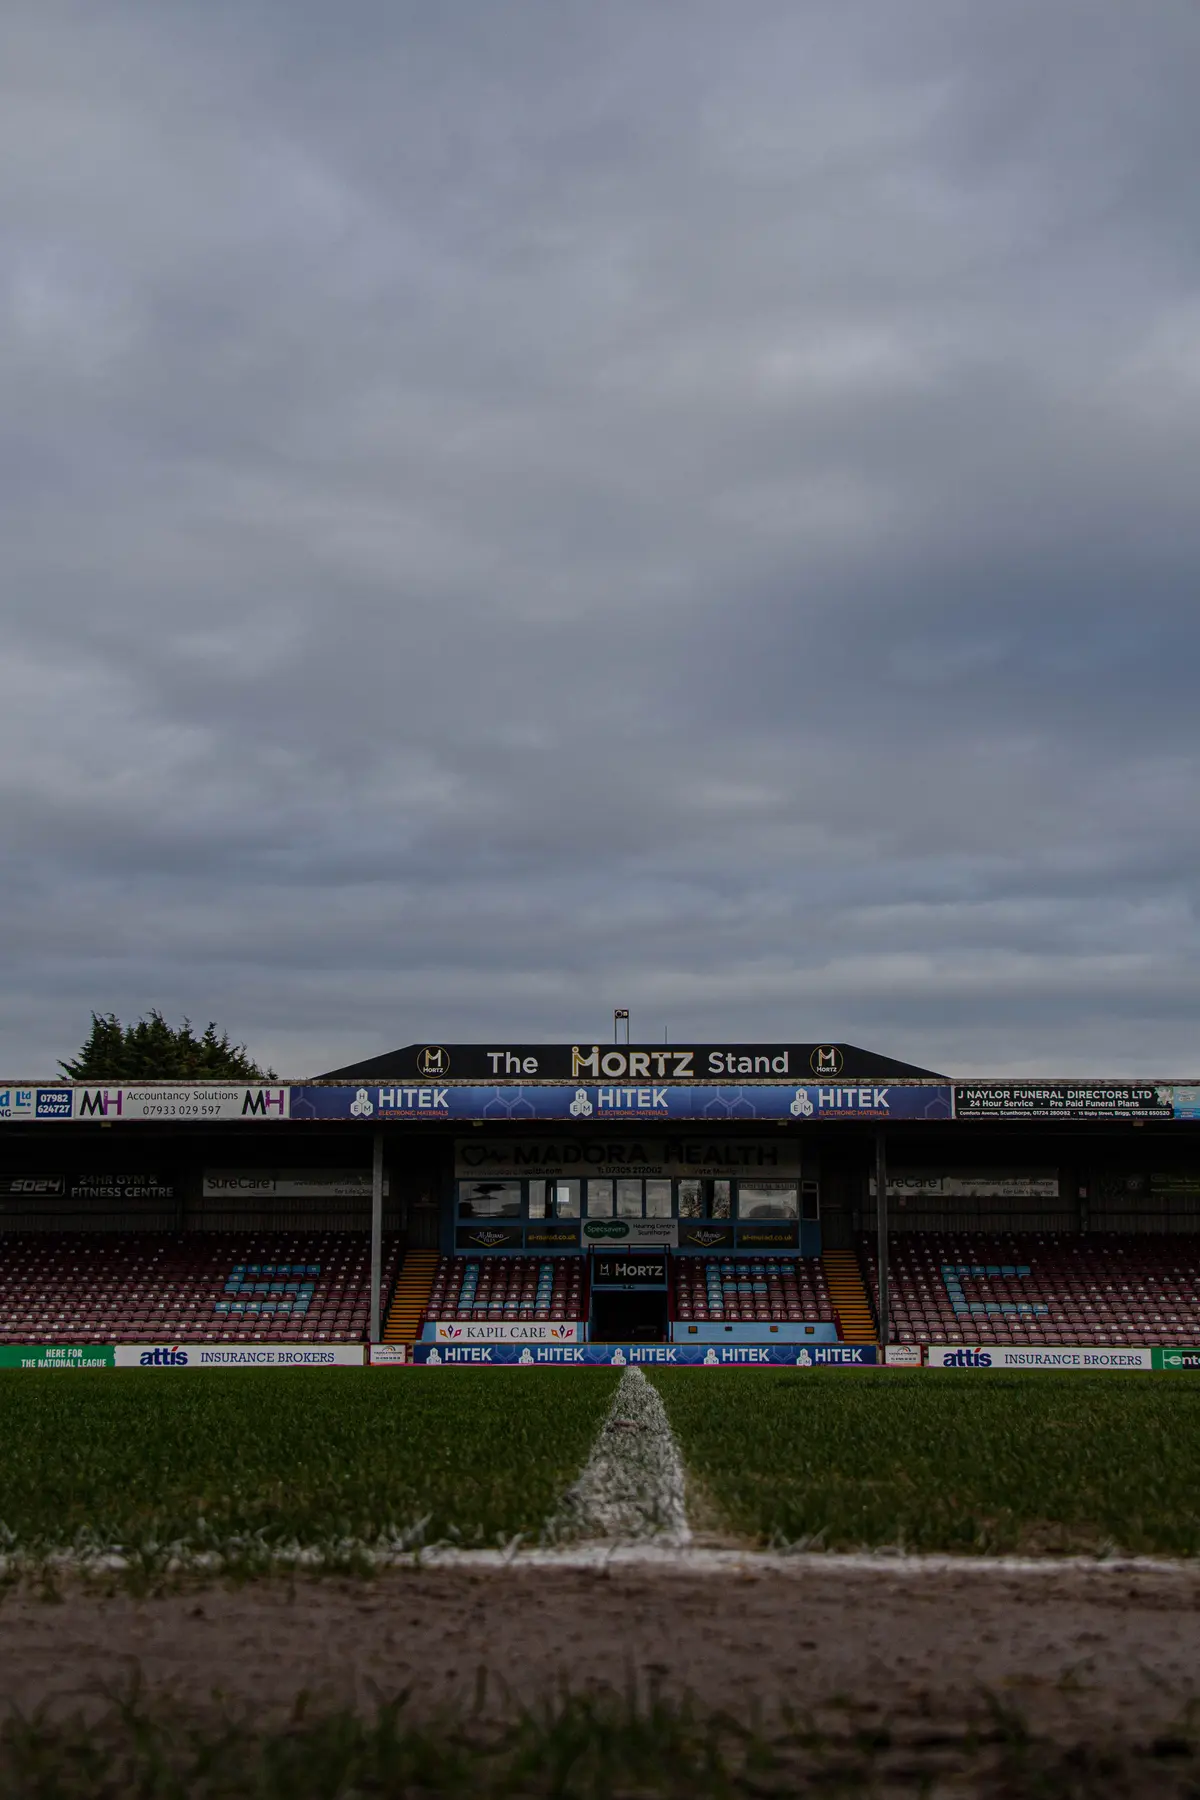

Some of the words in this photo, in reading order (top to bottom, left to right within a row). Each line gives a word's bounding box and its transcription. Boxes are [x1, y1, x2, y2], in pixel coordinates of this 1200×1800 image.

[486, 1052, 538, 1074] The
[572, 1046, 694, 1078] MORTZ
[708, 1051, 789, 1074] Stand
[40, 1094, 68, 1102] 07982
[127, 1091, 190, 1101] Accountancy
[194, 1091, 238, 1100] Solutions
[378, 1089, 449, 1108] HITEK
[598, 1089, 668, 1108] HITEK
[818, 1089, 890, 1108] HITEK
[958, 1090, 963, 1099] J
[967, 1090, 1010, 1099] NAYLOR
[1014, 1090, 1064, 1099] FUNERAL
[1067, 1090, 1128, 1099] DIRECTORS
[1132, 1090, 1152, 1099] LTD
[38, 1105, 70, 1114] 624727
[143, 1106, 176, 1115] 07933
[179, 1106, 198, 1115] 029
[202, 1106, 221, 1115] 597
[515, 1144, 648, 1164] MADORA
[664, 1144, 778, 1166] HEALTH
[80, 1174, 113, 1185] 24HR
[116, 1174, 144, 1185] GYM
[148, 1174, 160, 1185] &
[208, 1176, 270, 1189] SureCare
[71, 1187, 121, 1198] FITNESS
[124, 1187, 175, 1198] CENTRE
[615, 1263, 664, 1276] MORTZ
[467, 1327, 506, 1338] KAPIL
[510, 1327, 546, 1338] CARE
[46, 1349, 66, 1358] HERE
[68, 1349, 83, 1358] FOR
[140, 1346, 188, 1365] attis
[201, 1352, 274, 1363] INSURANCE
[278, 1352, 335, 1363] BROKERS
[444, 1348, 492, 1362] HITEK
[537, 1348, 584, 1362] HITEK
[630, 1348, 677, 1362] HITEK
[722, 1348, 770, 1362] HITEK
[815, 1348, 863, 1362] HITEK
[943, 1347, 991, 1367] attis
[1005, 1354, 1080, 1364] INSURANCE
[1084, 1354, 1142, 1366] BROKERS
[21, 1359, 36, 1368] THE
[38, 1359, 76, 1368] NATIONAL
[78, 1359, 107, 1368] LEAGUE
